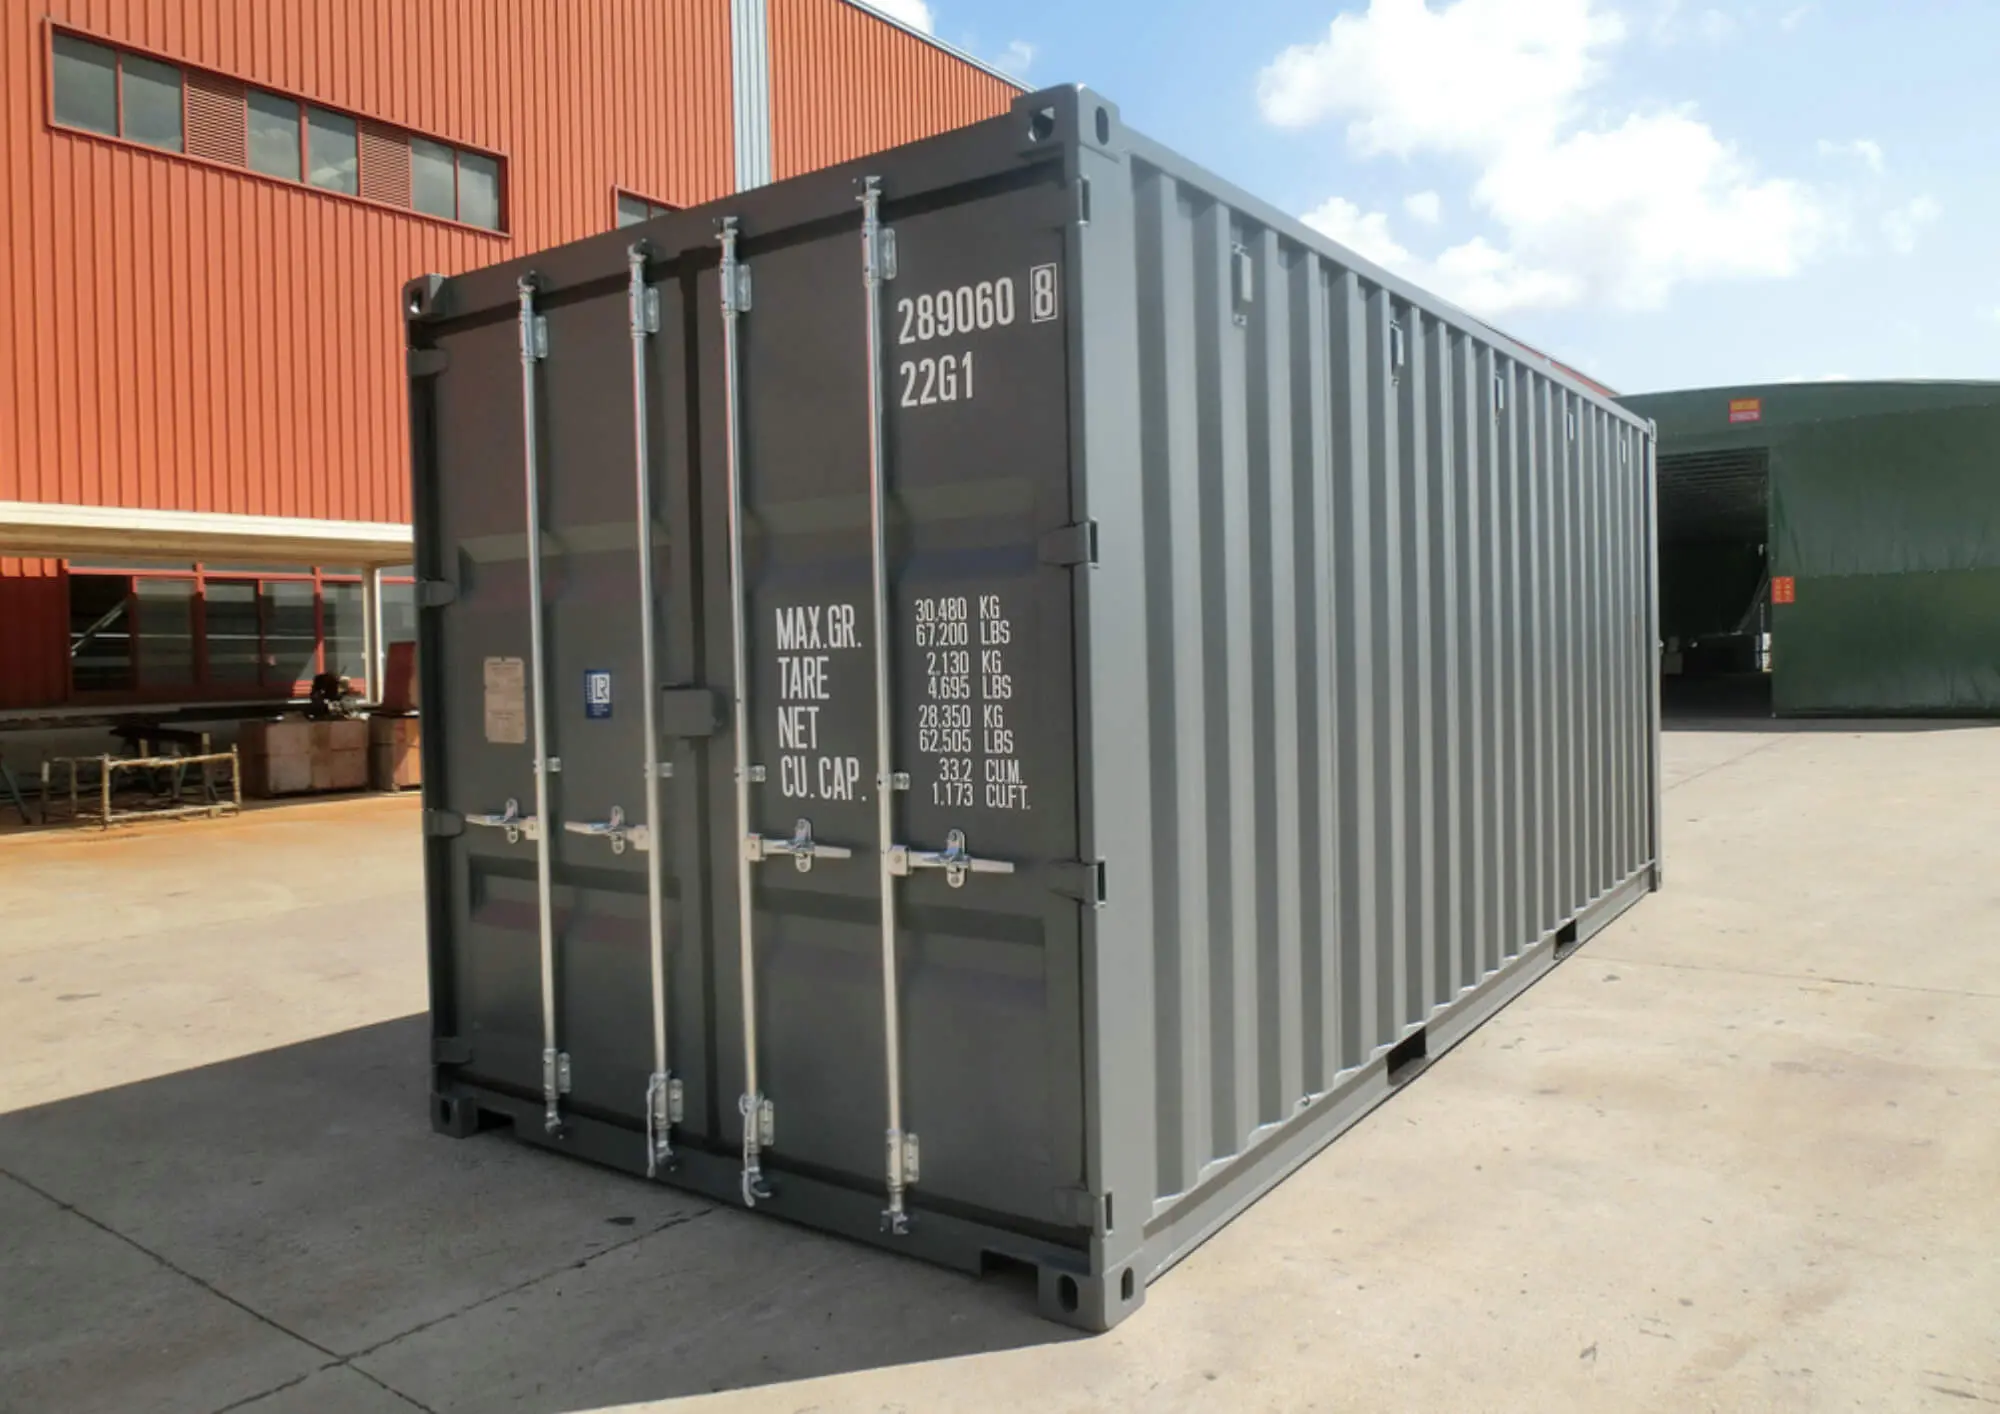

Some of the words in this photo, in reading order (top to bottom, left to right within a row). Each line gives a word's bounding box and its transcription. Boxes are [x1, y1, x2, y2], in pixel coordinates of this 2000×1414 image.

[898, 276, 1015, 345] 289060
[1033, 268, 1054, 317] 8
[900, 351, 973, 408] 22G1
[915, 596, 968, 622] 30.480
[979, 595, 1000, 620] KG
[915, 621, 968, 647] 67.200
[980, 620, 1011, 645] LBS
[926, 650, 970, 676] 2.130
[981, 649, 1002, 674] KG
[778, 656, 830, 699] TARE
[927, 675, 971, 700] 4.695
[982, 674, 1013, 700] LBS
[778, 706, 819, 749] NET
[918, 704, 972, 729] 28.350
[983, 704, 1004, 729] KG
[919, 728, 972, 753] 62.505
[984, 729, 1015, 754] LBS
[932, 781, 974, 807] 1.173
